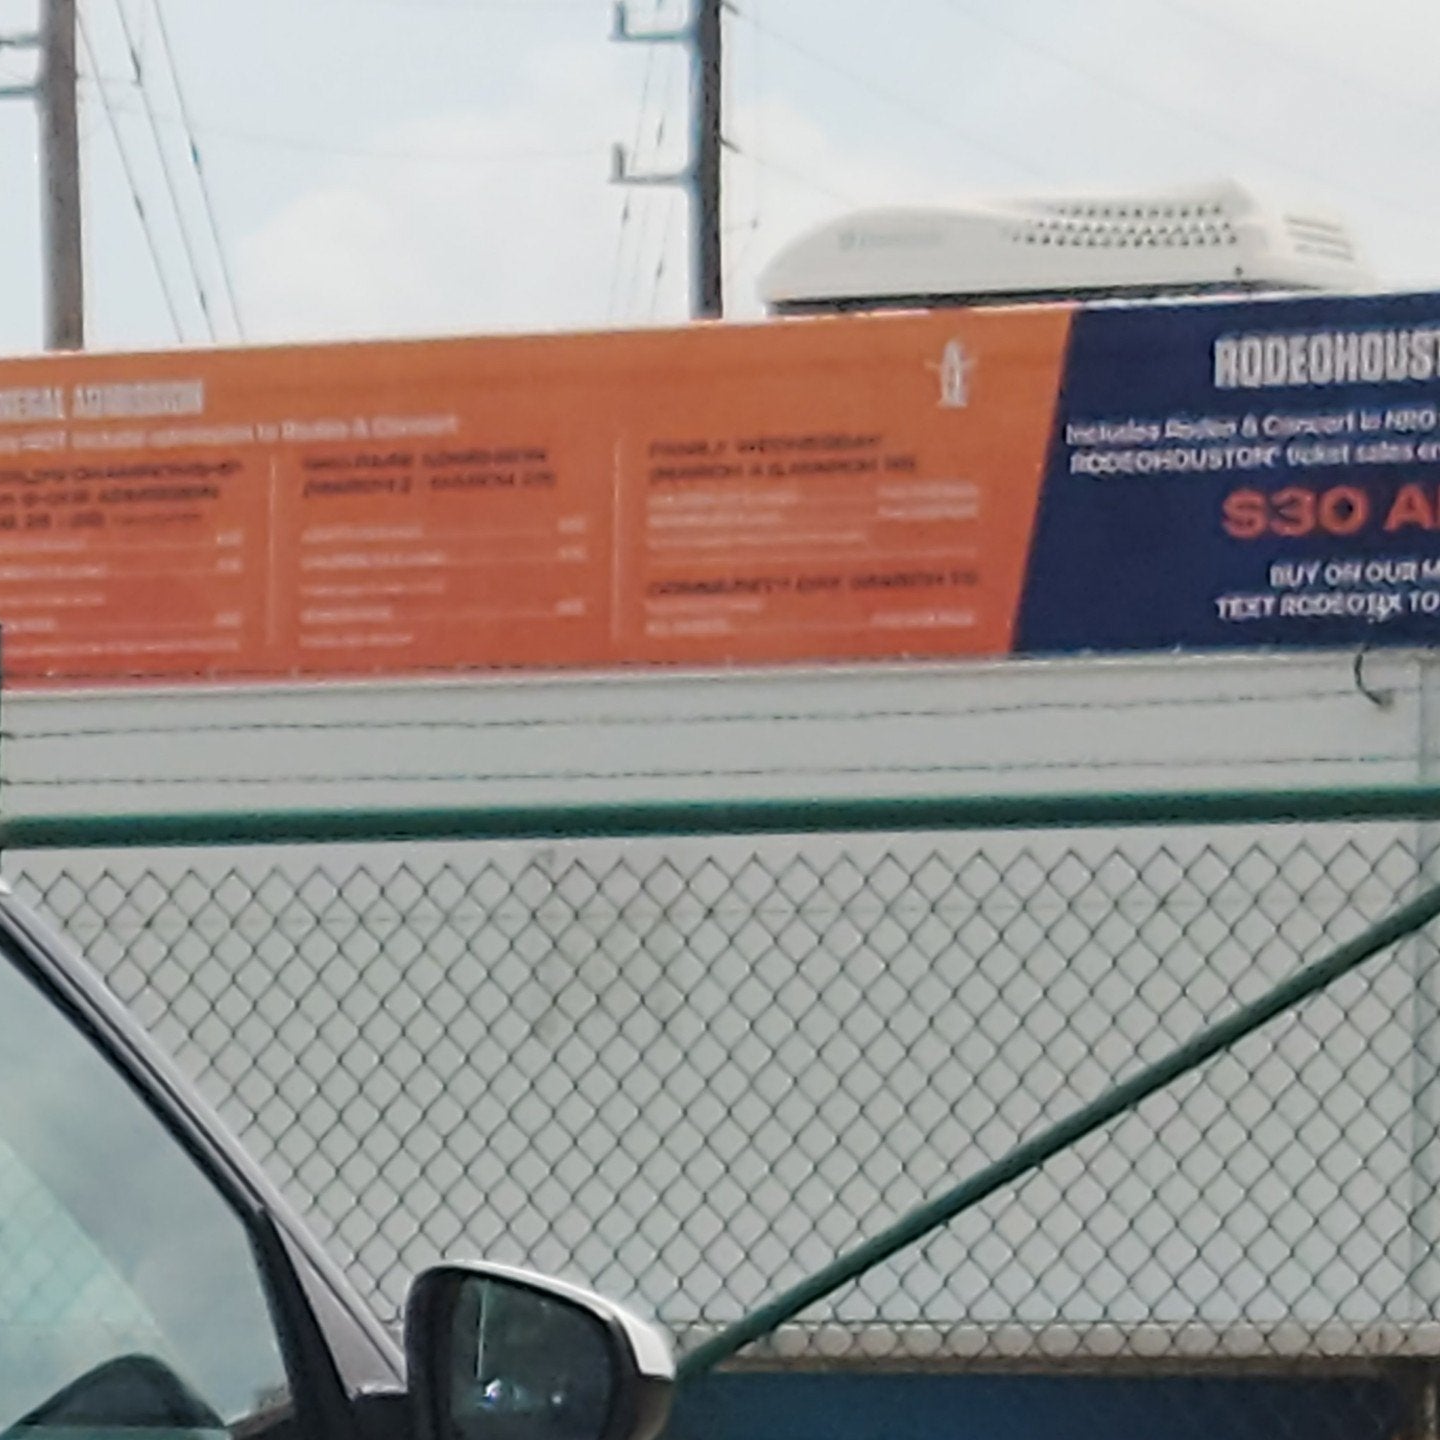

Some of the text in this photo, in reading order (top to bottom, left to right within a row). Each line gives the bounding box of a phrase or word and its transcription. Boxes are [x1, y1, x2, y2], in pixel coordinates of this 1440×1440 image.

[1270, 560, 1321, 587] BUY
[1324, 561, 1362, 586] ON
[1365, 559, 1417, 584] OUR
[1215, 594, 1276, 619] TEXT
